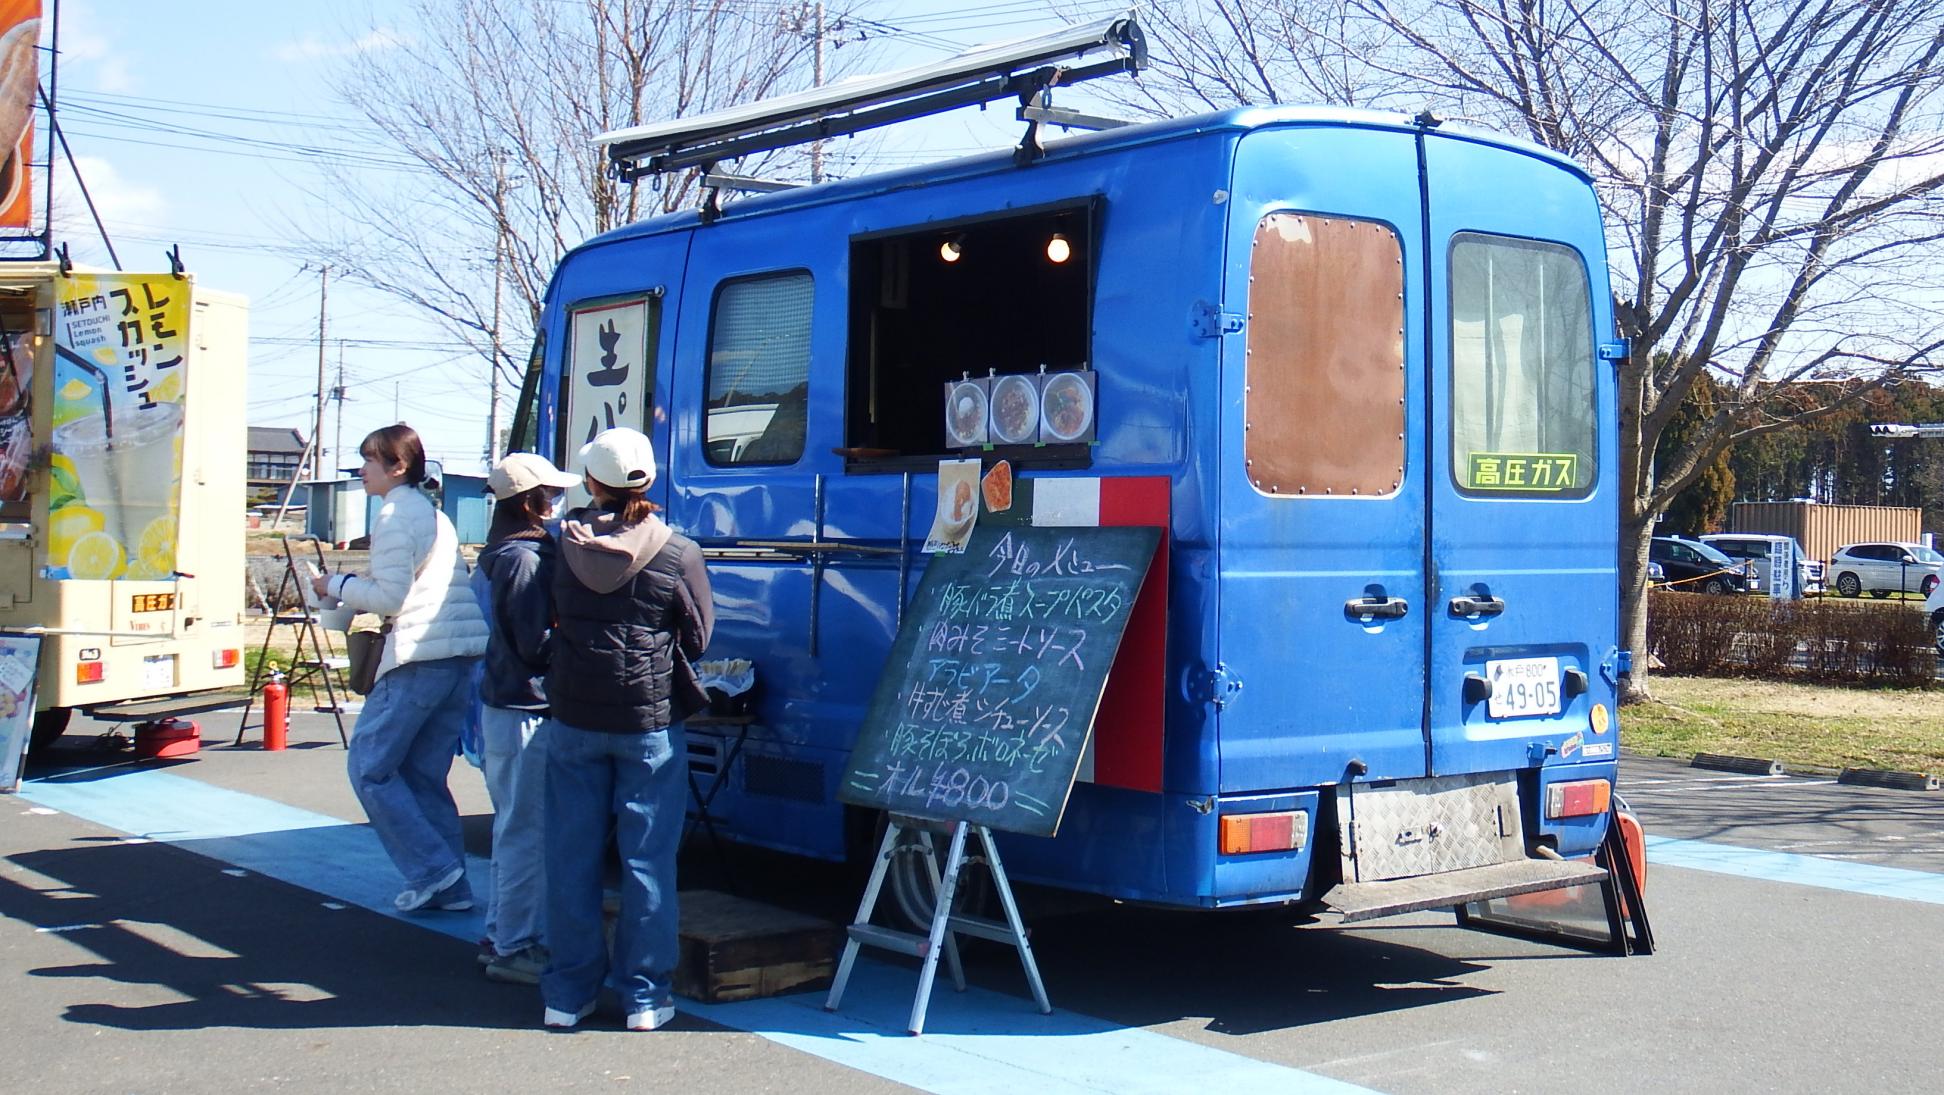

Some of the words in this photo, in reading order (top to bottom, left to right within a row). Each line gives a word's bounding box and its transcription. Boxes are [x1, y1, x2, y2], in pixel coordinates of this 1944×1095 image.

[109, 288, 157, 411] スカッシュ
[142, 283, 183, 370] レモン
[1476, 458, 1572, 486] 高圧ガス
[928, 658, 1041, 705] アラビアータ
